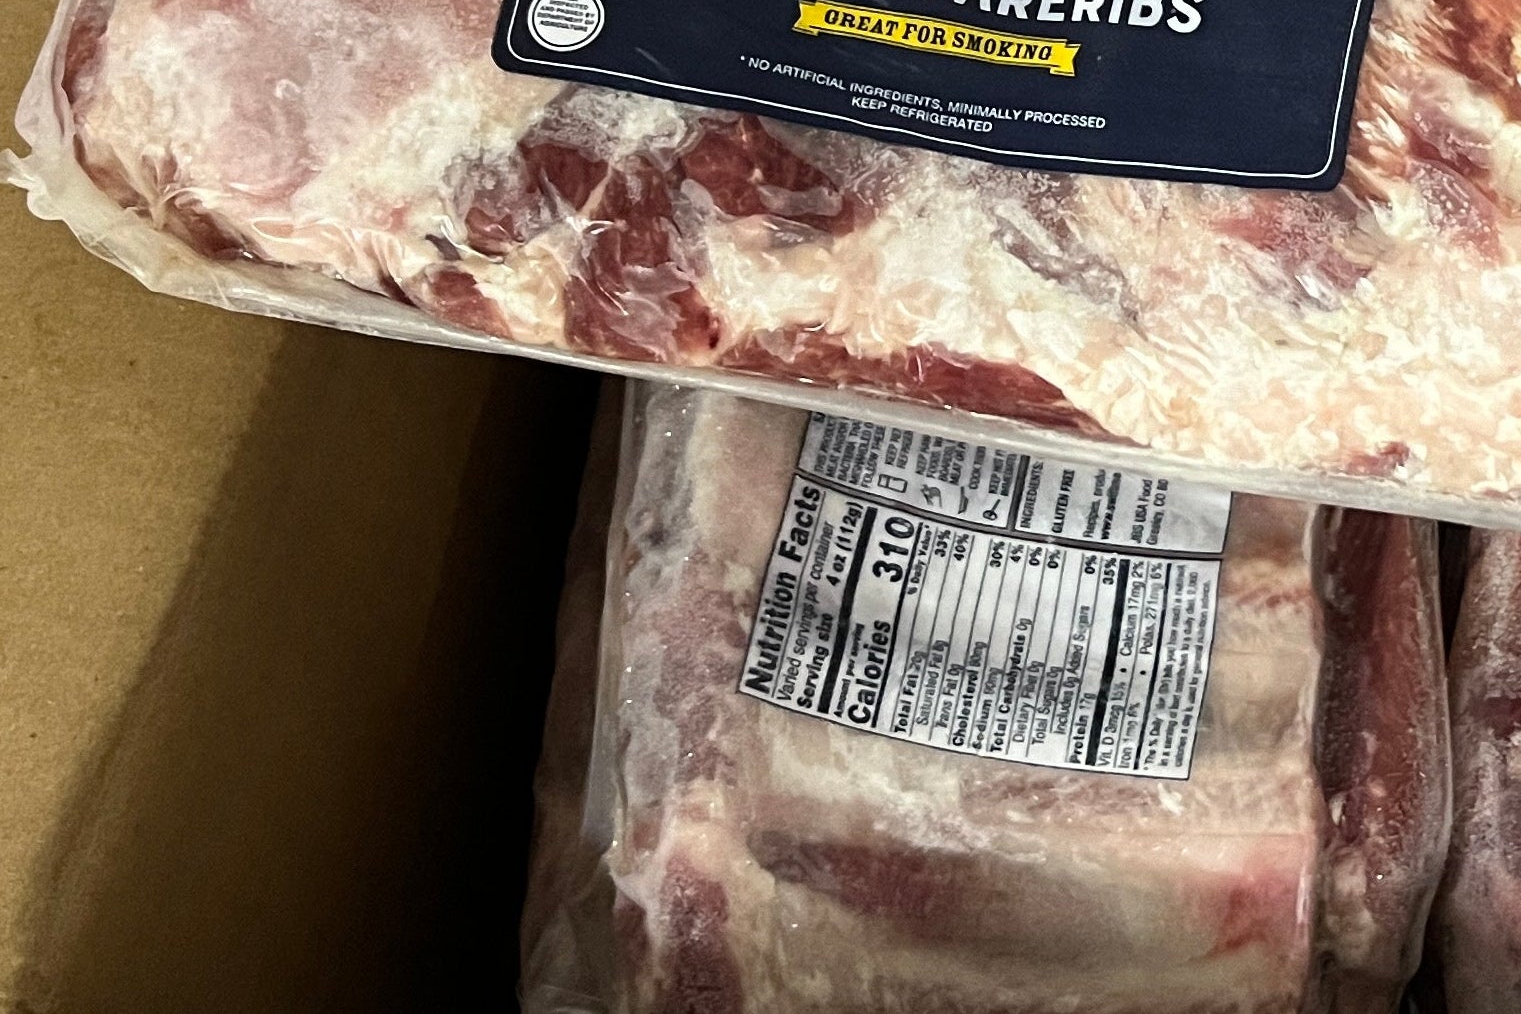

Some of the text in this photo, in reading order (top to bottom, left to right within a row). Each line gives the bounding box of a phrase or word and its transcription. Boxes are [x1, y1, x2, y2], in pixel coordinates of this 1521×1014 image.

[748, 57, 1106, 130] NO ARTIFICIAL INGREDIENTS, MINIMALLY PROCESSED
[823, 9, 1053, 62] GREAT FOR SMOKING
[851, 95, 994, 133] KEEP REFRIGERATED
[1020, 461, 1043, 528] INGREDIENTS:
[1052, 494, 1070, 534] GLUTEN
[1134, 504, 1148, 523] USA
[1154, 493, 1166, 507] CO
[745, 486, 820, 694] Nutrition Facts
[777, 521, 835, 701] Varied servings per container
[797, 501, 864, 709] Serving size 4 oz (112g)
[847, 619, 891, 725] Calories
[872, 516, 914, 583] 310
[895, 529, 951, 734] Total Fat 33%
[915, 671, 939, 726] Saturated
[953, 533, 969, 562] 40%
[1128, 580, 1146, 610] 17mg
[1131, 560, 1144, 579] 2%
[936, 663, 965, 729] Trans Fat 0g
[952, 541, 1005, 747] Cholesterol 30%
[972, 544, 1024, 750] Sodium 4%
[990, 547, 1042, 752] Total Carbohydrate 0g 0%
[1013, 700, 1035, 744] Dietary
[1030, 660, 1046, 675] 0g
[1047, 548, 1060, 570] 0%
[1054, 689, 1073, 736] Includes
[1084, 554, 1097, 575] 0%
[1069, 715, 1088, 764] Protein
[1079, 692, 1097, 710] 17g
[1102, 557, 1117, 586] 35%
[1117, 742, 1133, 769] Iron
[1150, 562, 1163, 580] 6%
[1120, 614, 1137, 657] Calcium
[1032, 717, 1048, 745] Total
[1047, 666, 1065, 679] 0g
[1101, 736, 1115, 747] D
